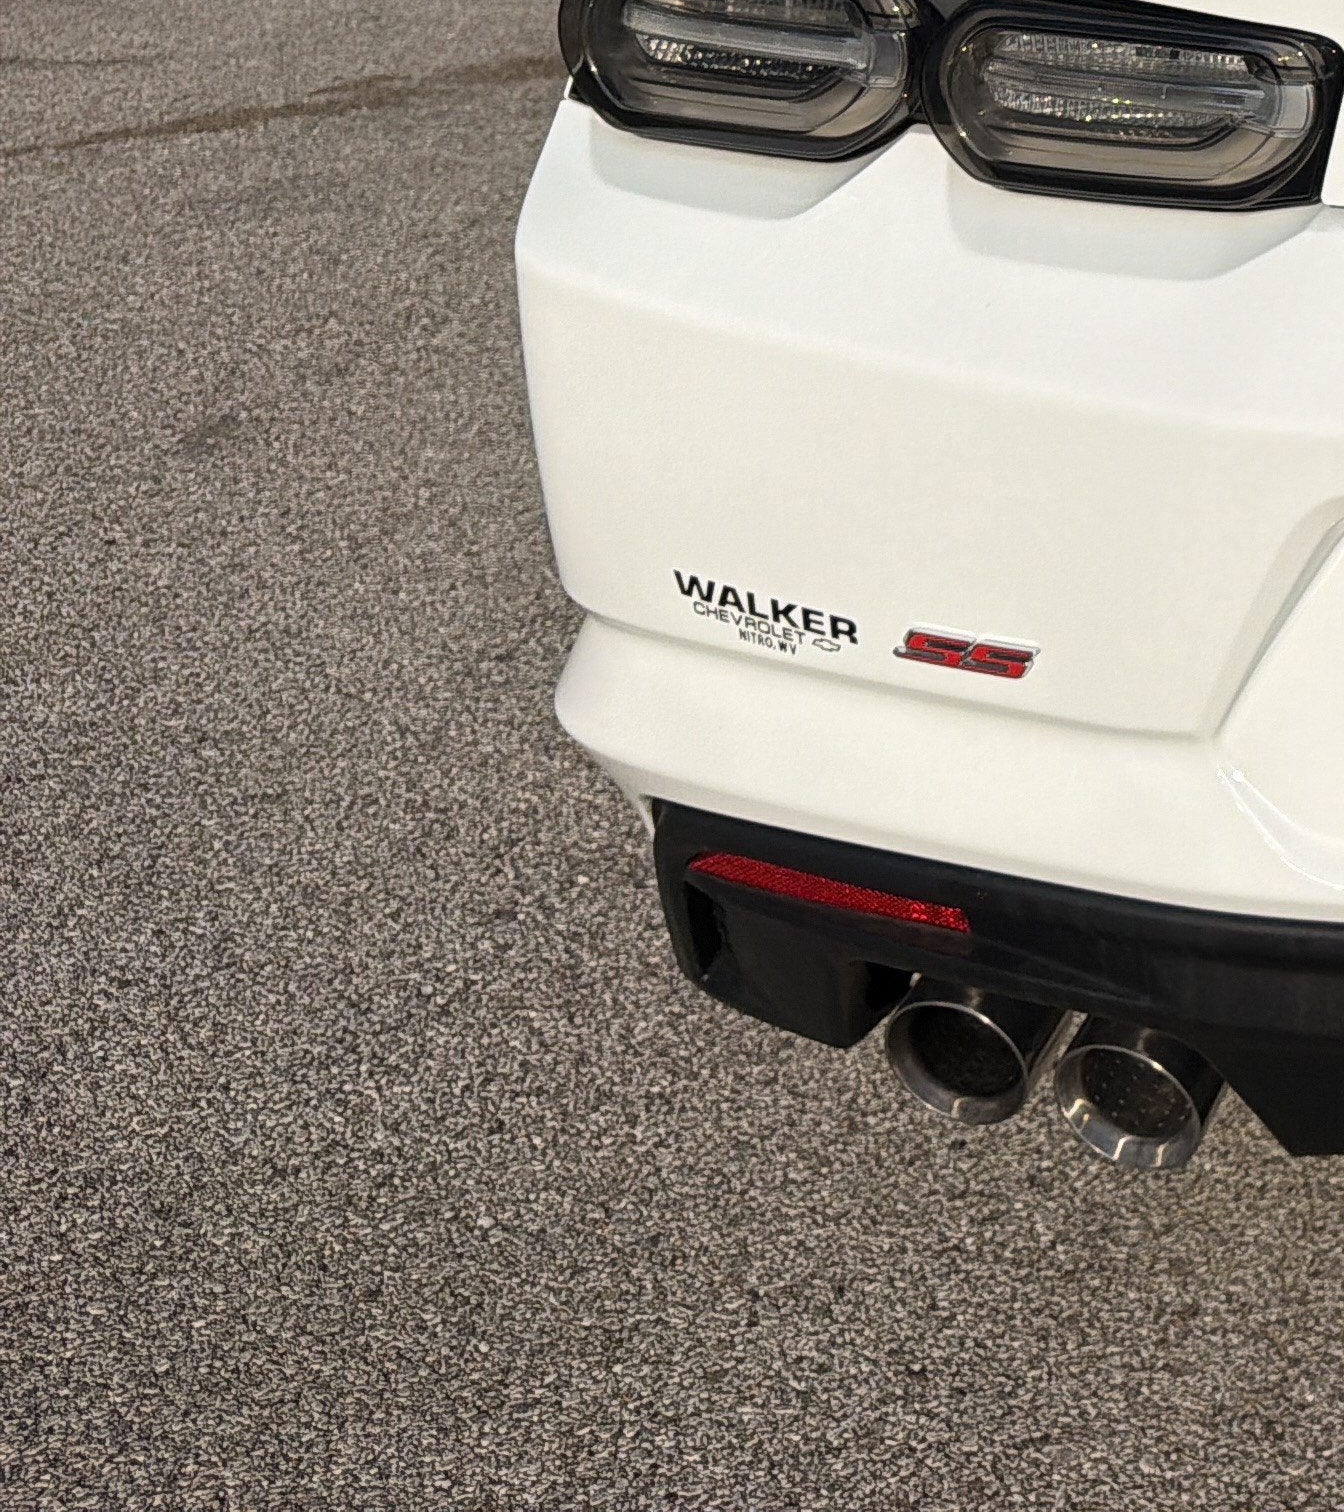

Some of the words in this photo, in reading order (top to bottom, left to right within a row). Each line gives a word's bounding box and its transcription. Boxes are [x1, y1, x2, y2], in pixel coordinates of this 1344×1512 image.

[672, 568, 859, 645] WALKER
[692, 600, 806, 645] CHEVROLET
[892, 624, 1041, 680] SS
